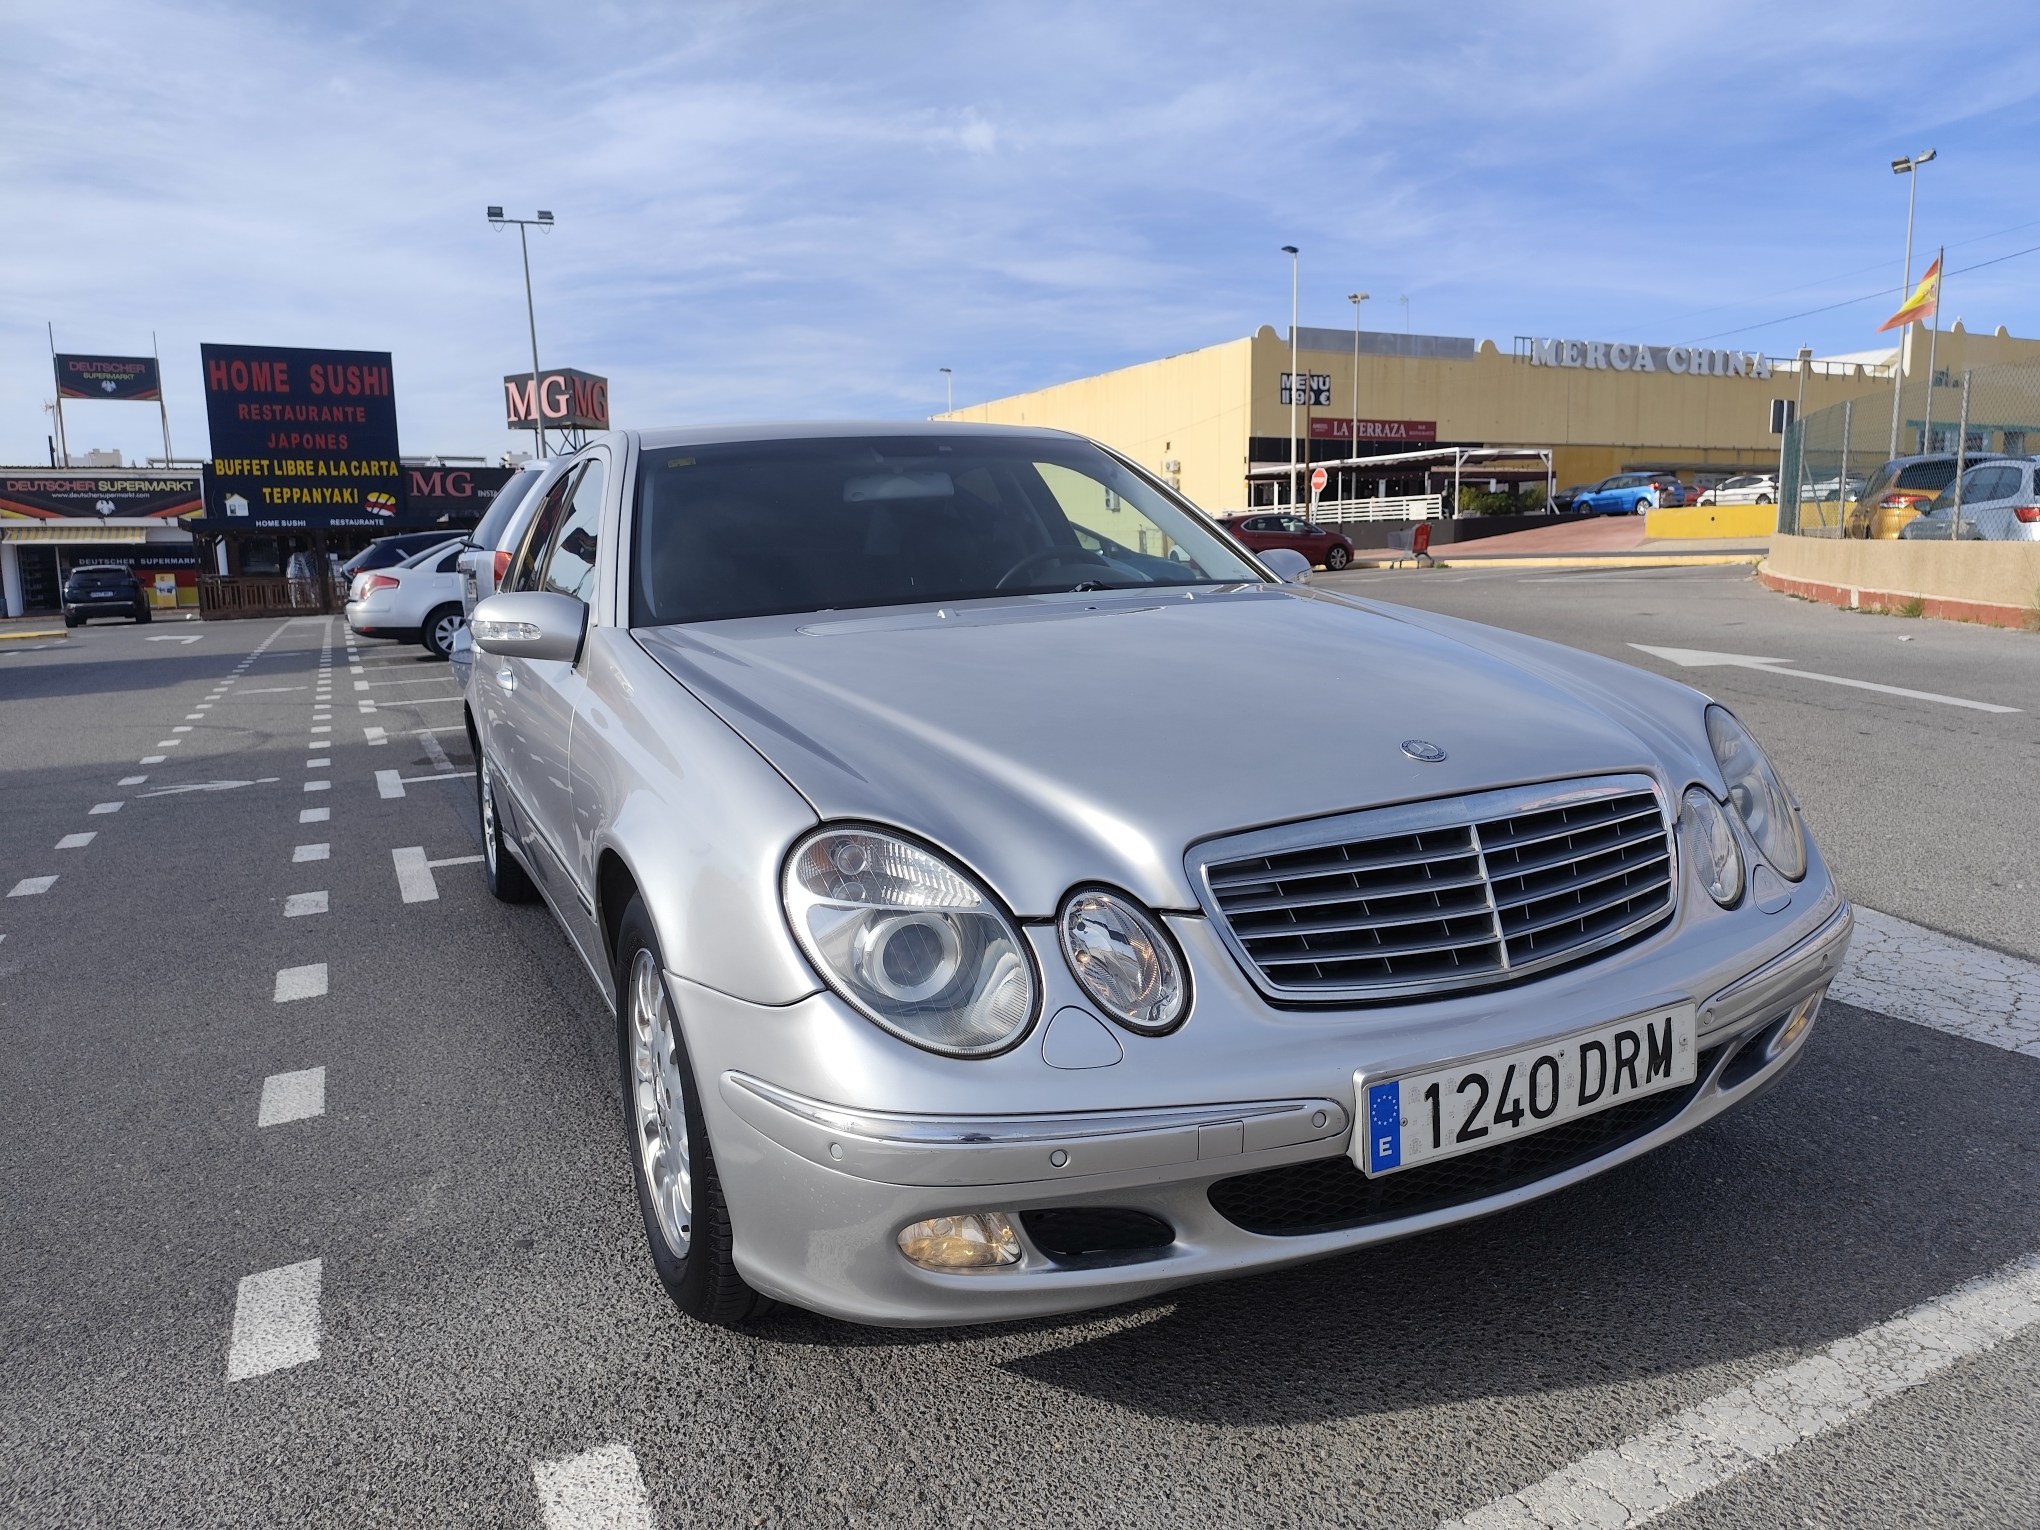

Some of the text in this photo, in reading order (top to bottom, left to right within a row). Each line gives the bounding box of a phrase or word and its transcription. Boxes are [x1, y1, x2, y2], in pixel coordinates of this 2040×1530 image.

[69, 361, 146, 373] DEUTSCHER
[1531, 338, 1772, 379] MERCA CHINA
[83, 372, 135, 380] SUPERMARKT
[209, 359, 389, 396] HOME SUSHI
[505, 375, 570, 422] MG
[571, 375, 607, 422] MG
[238, 403, 366, 423] RESTAURANTE
[1333, 421, 1349, 436] LA
[1351, 422, 1406, 437] TERRAZA
[267, 432, 348, 449] JAPONES
[214, 459, 399, 476] BUFFET LIBRE A LA CARTA
[7, 480, 194, 492] DEUTSCHER SUPERMARKT
[409, 470, 475, 497] MG
[52, 491, 150, 500] www.deutschersupermarkt.com
[262, 487, 359, 504] TEPPANYAKI
[255, 520, 280, 528] HOME
[330, 518, 384, 526] RESTAURANTE
[1424, 1016, 1673, 1149] 1240 DRM
[1379, 1136, 1392, 1158] E
